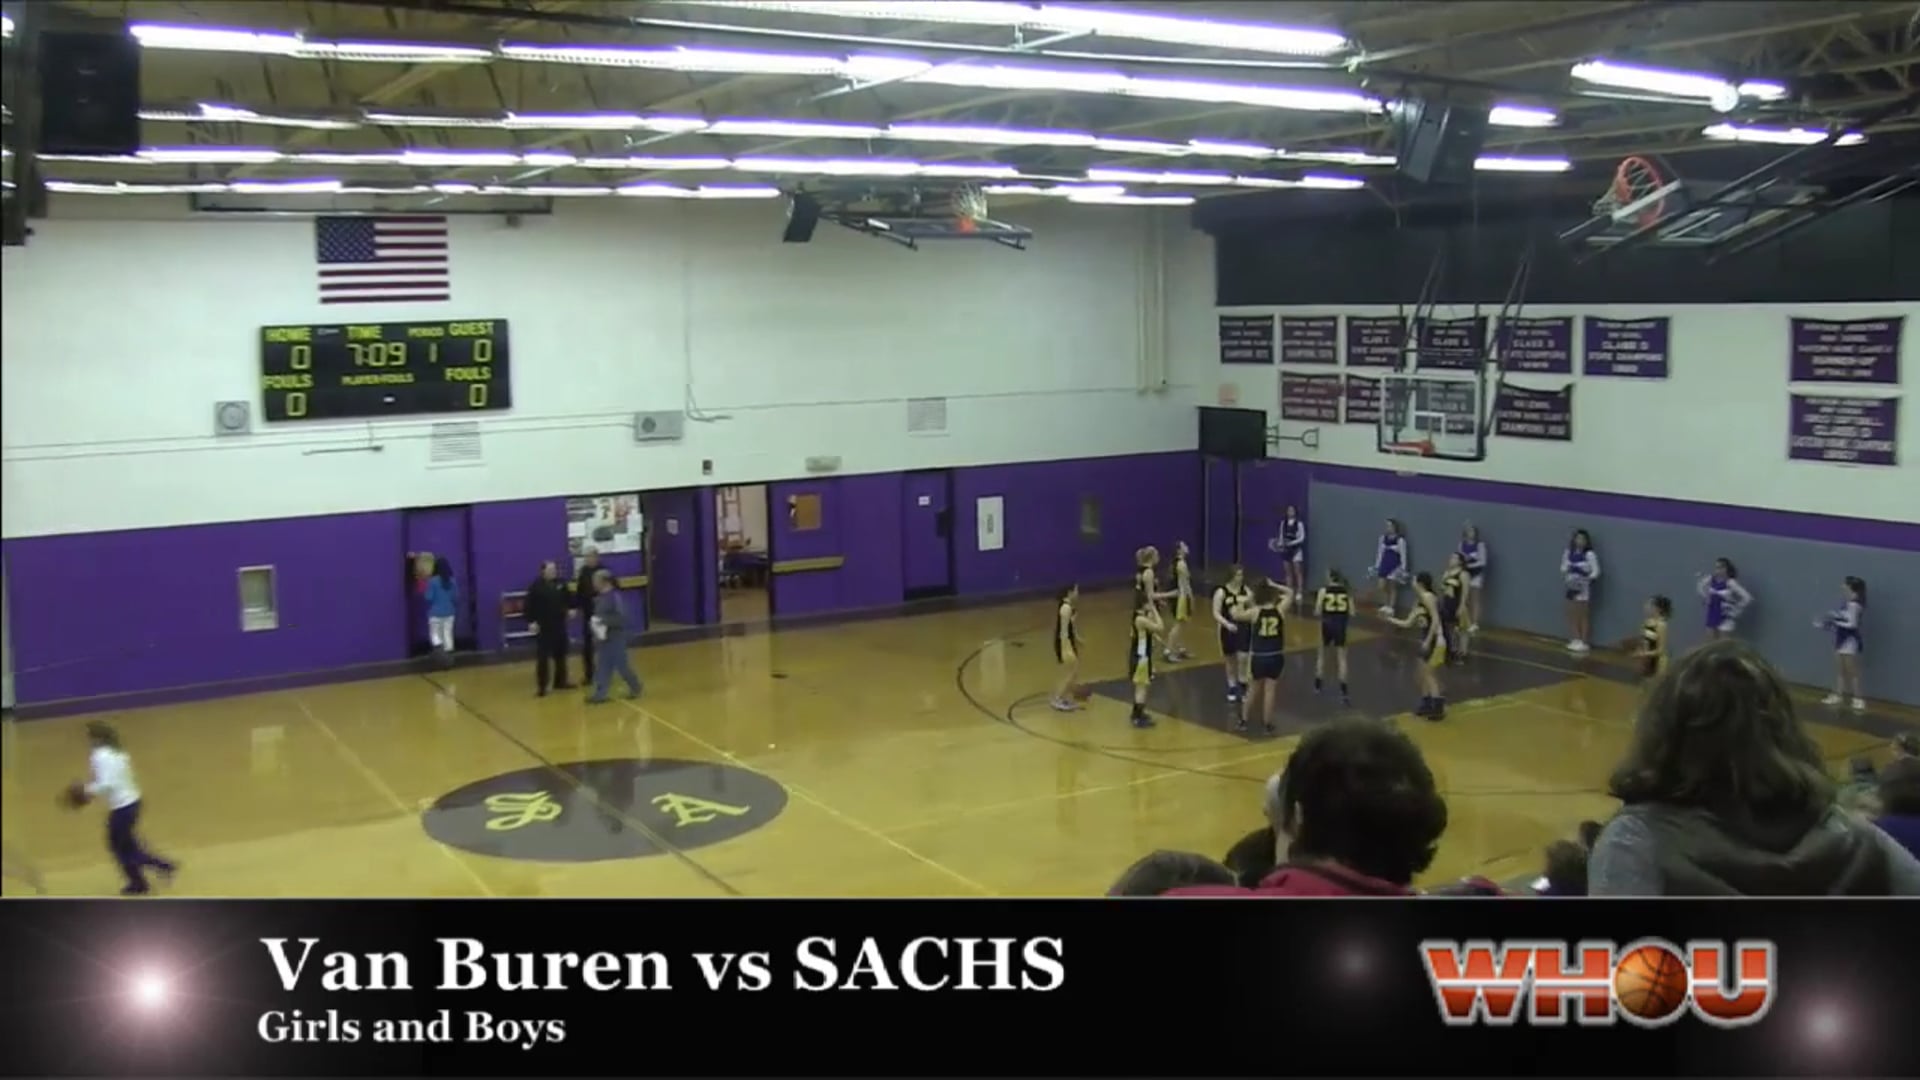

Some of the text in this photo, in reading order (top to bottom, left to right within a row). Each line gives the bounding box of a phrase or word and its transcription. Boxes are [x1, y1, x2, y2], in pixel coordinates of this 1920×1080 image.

[264, 327, 312, 342] HOME
[347, 325, 382, 339] TIME
[449, 321, 494, 336] GUEST
[290, 344, 311, 370] 0
[345, 341, 407, 367] 7:09
[473, 338, 493, 363] 0
[263, 374, 313, 389] FOULS
[445, 367, 492, 381] FOULS
[286, 392, 307, 417] 0
[468, 383, 488, 408] 0
[1324, 593, 1348, 613] 25
[1258, 616, 1280, 637] 12
